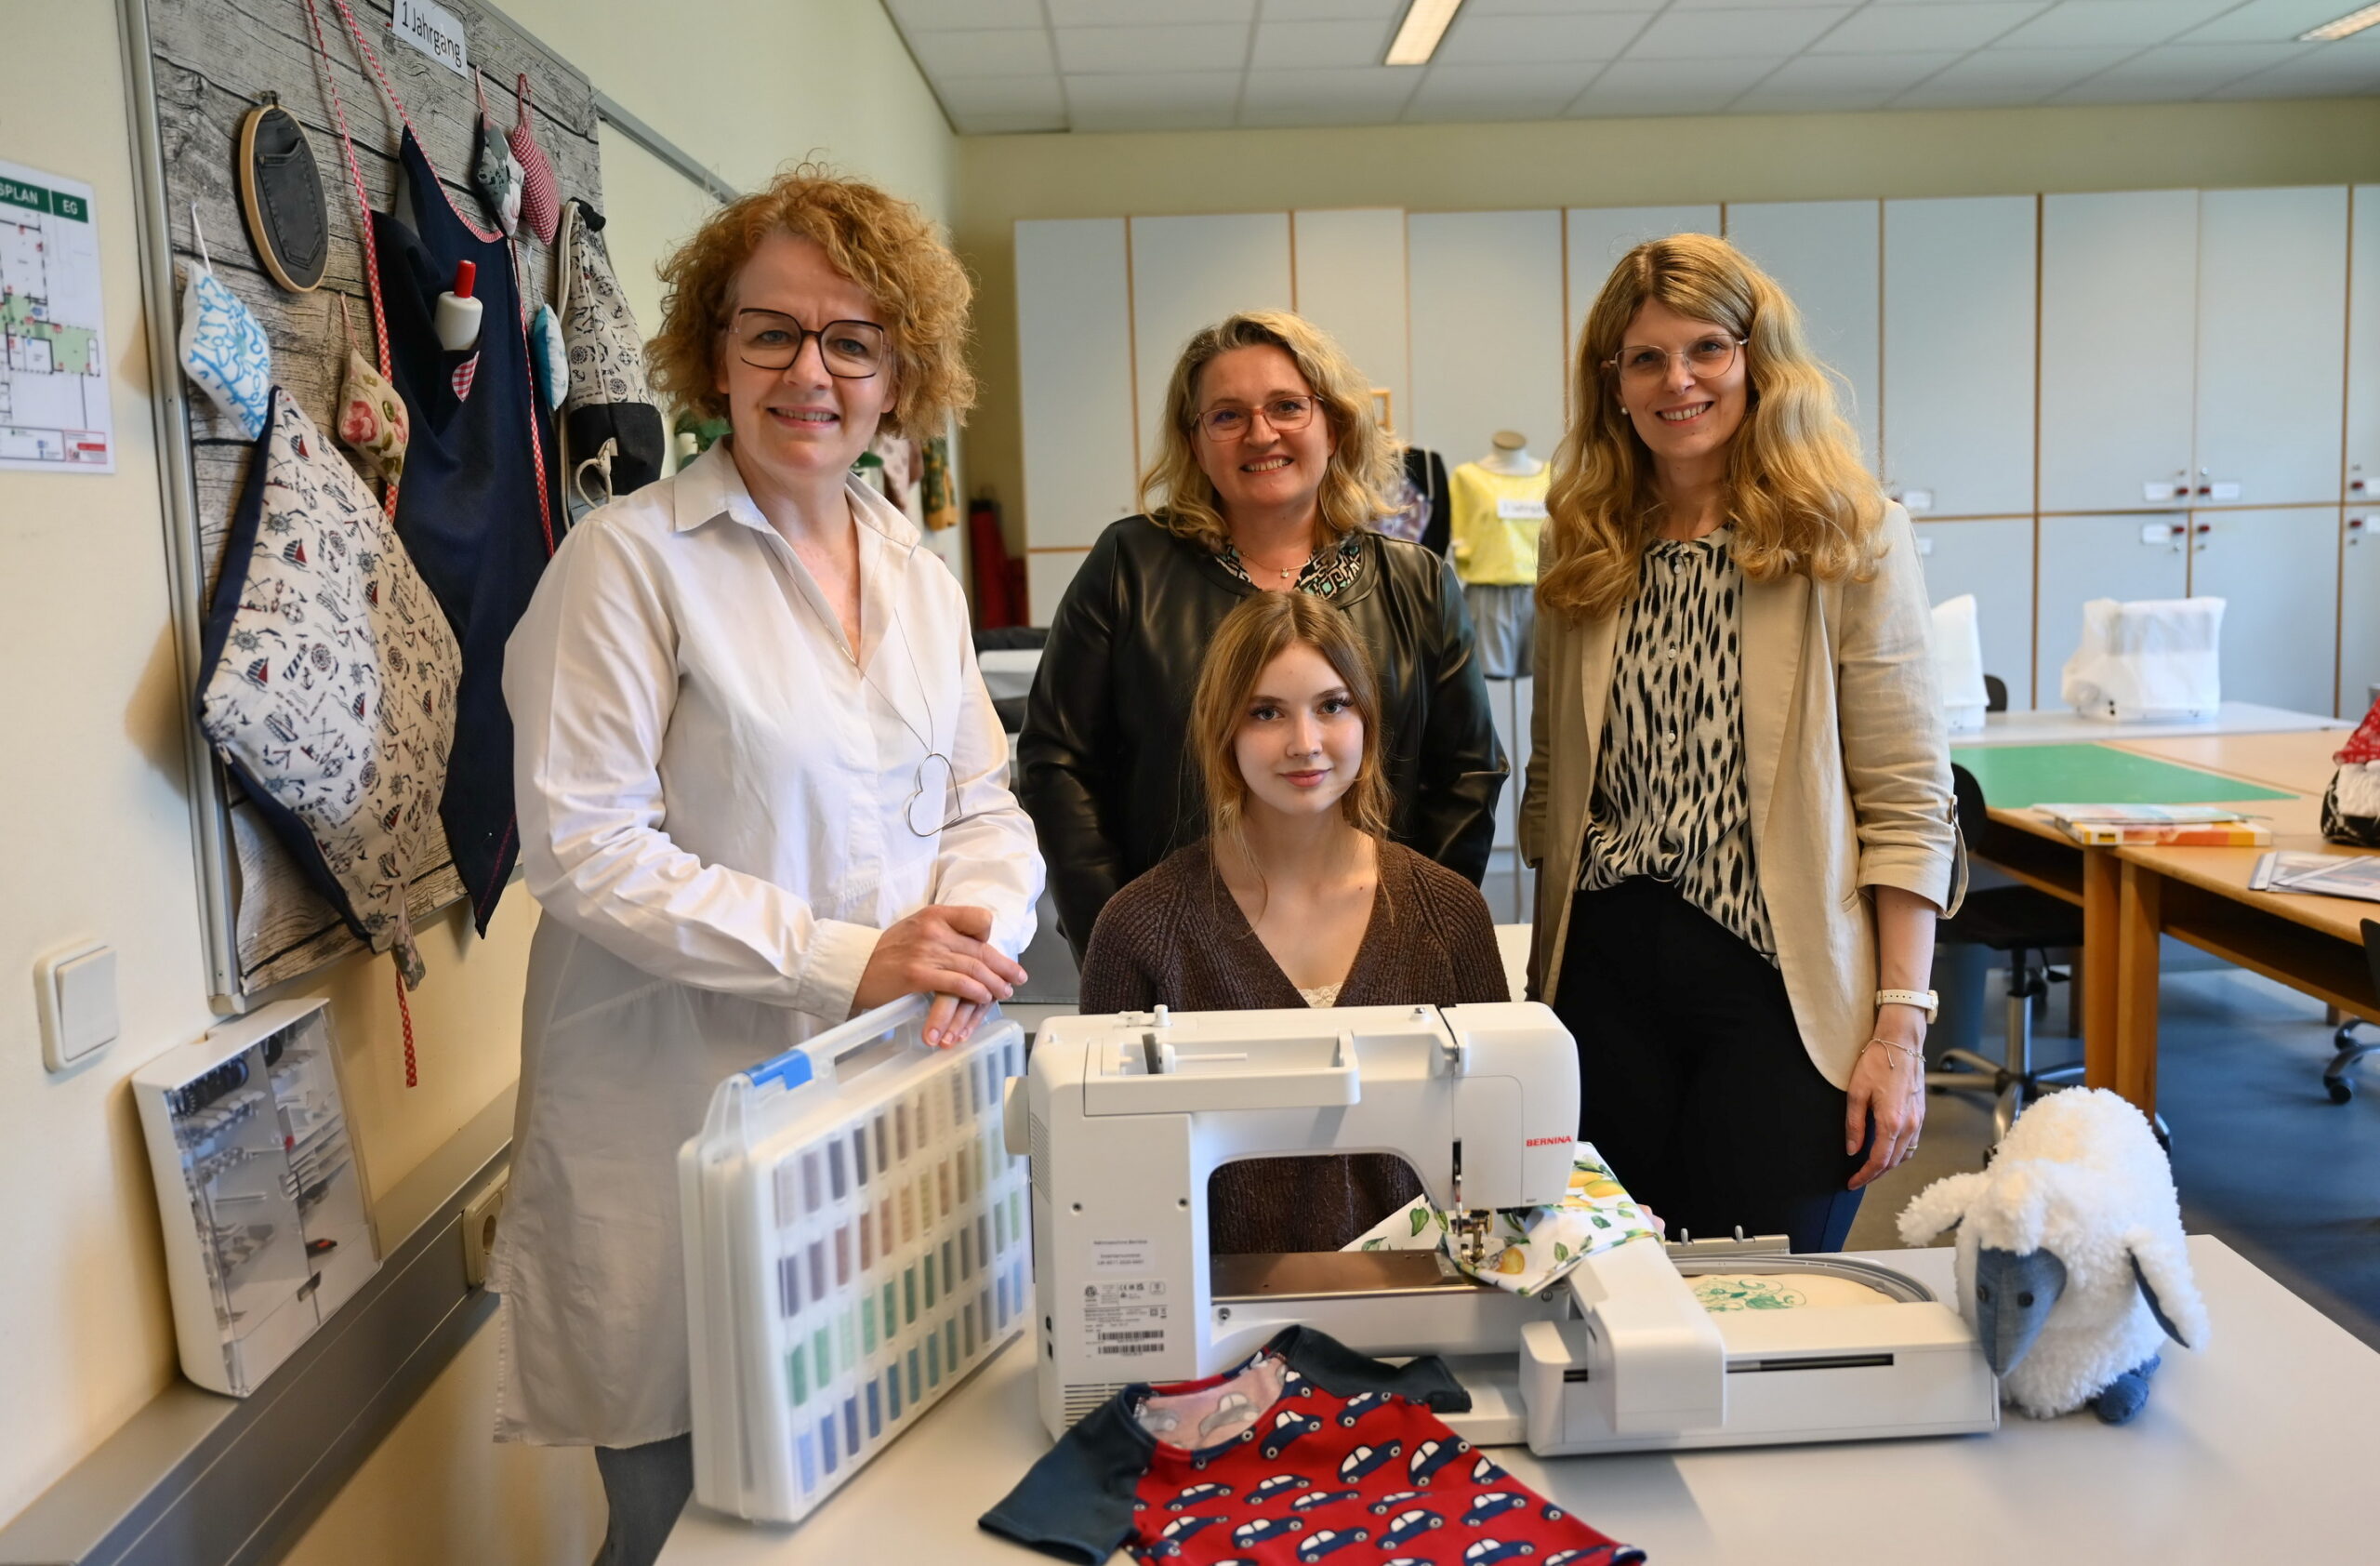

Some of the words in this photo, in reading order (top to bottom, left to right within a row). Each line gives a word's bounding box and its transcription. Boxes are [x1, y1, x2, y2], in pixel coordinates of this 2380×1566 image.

[402, 1, 409, 27] 1
[412, 7, 462, 68] Jahrgang
[62, 199, 78, 215] EG
[1527, 1135, 1571, 1147] BERNINA
